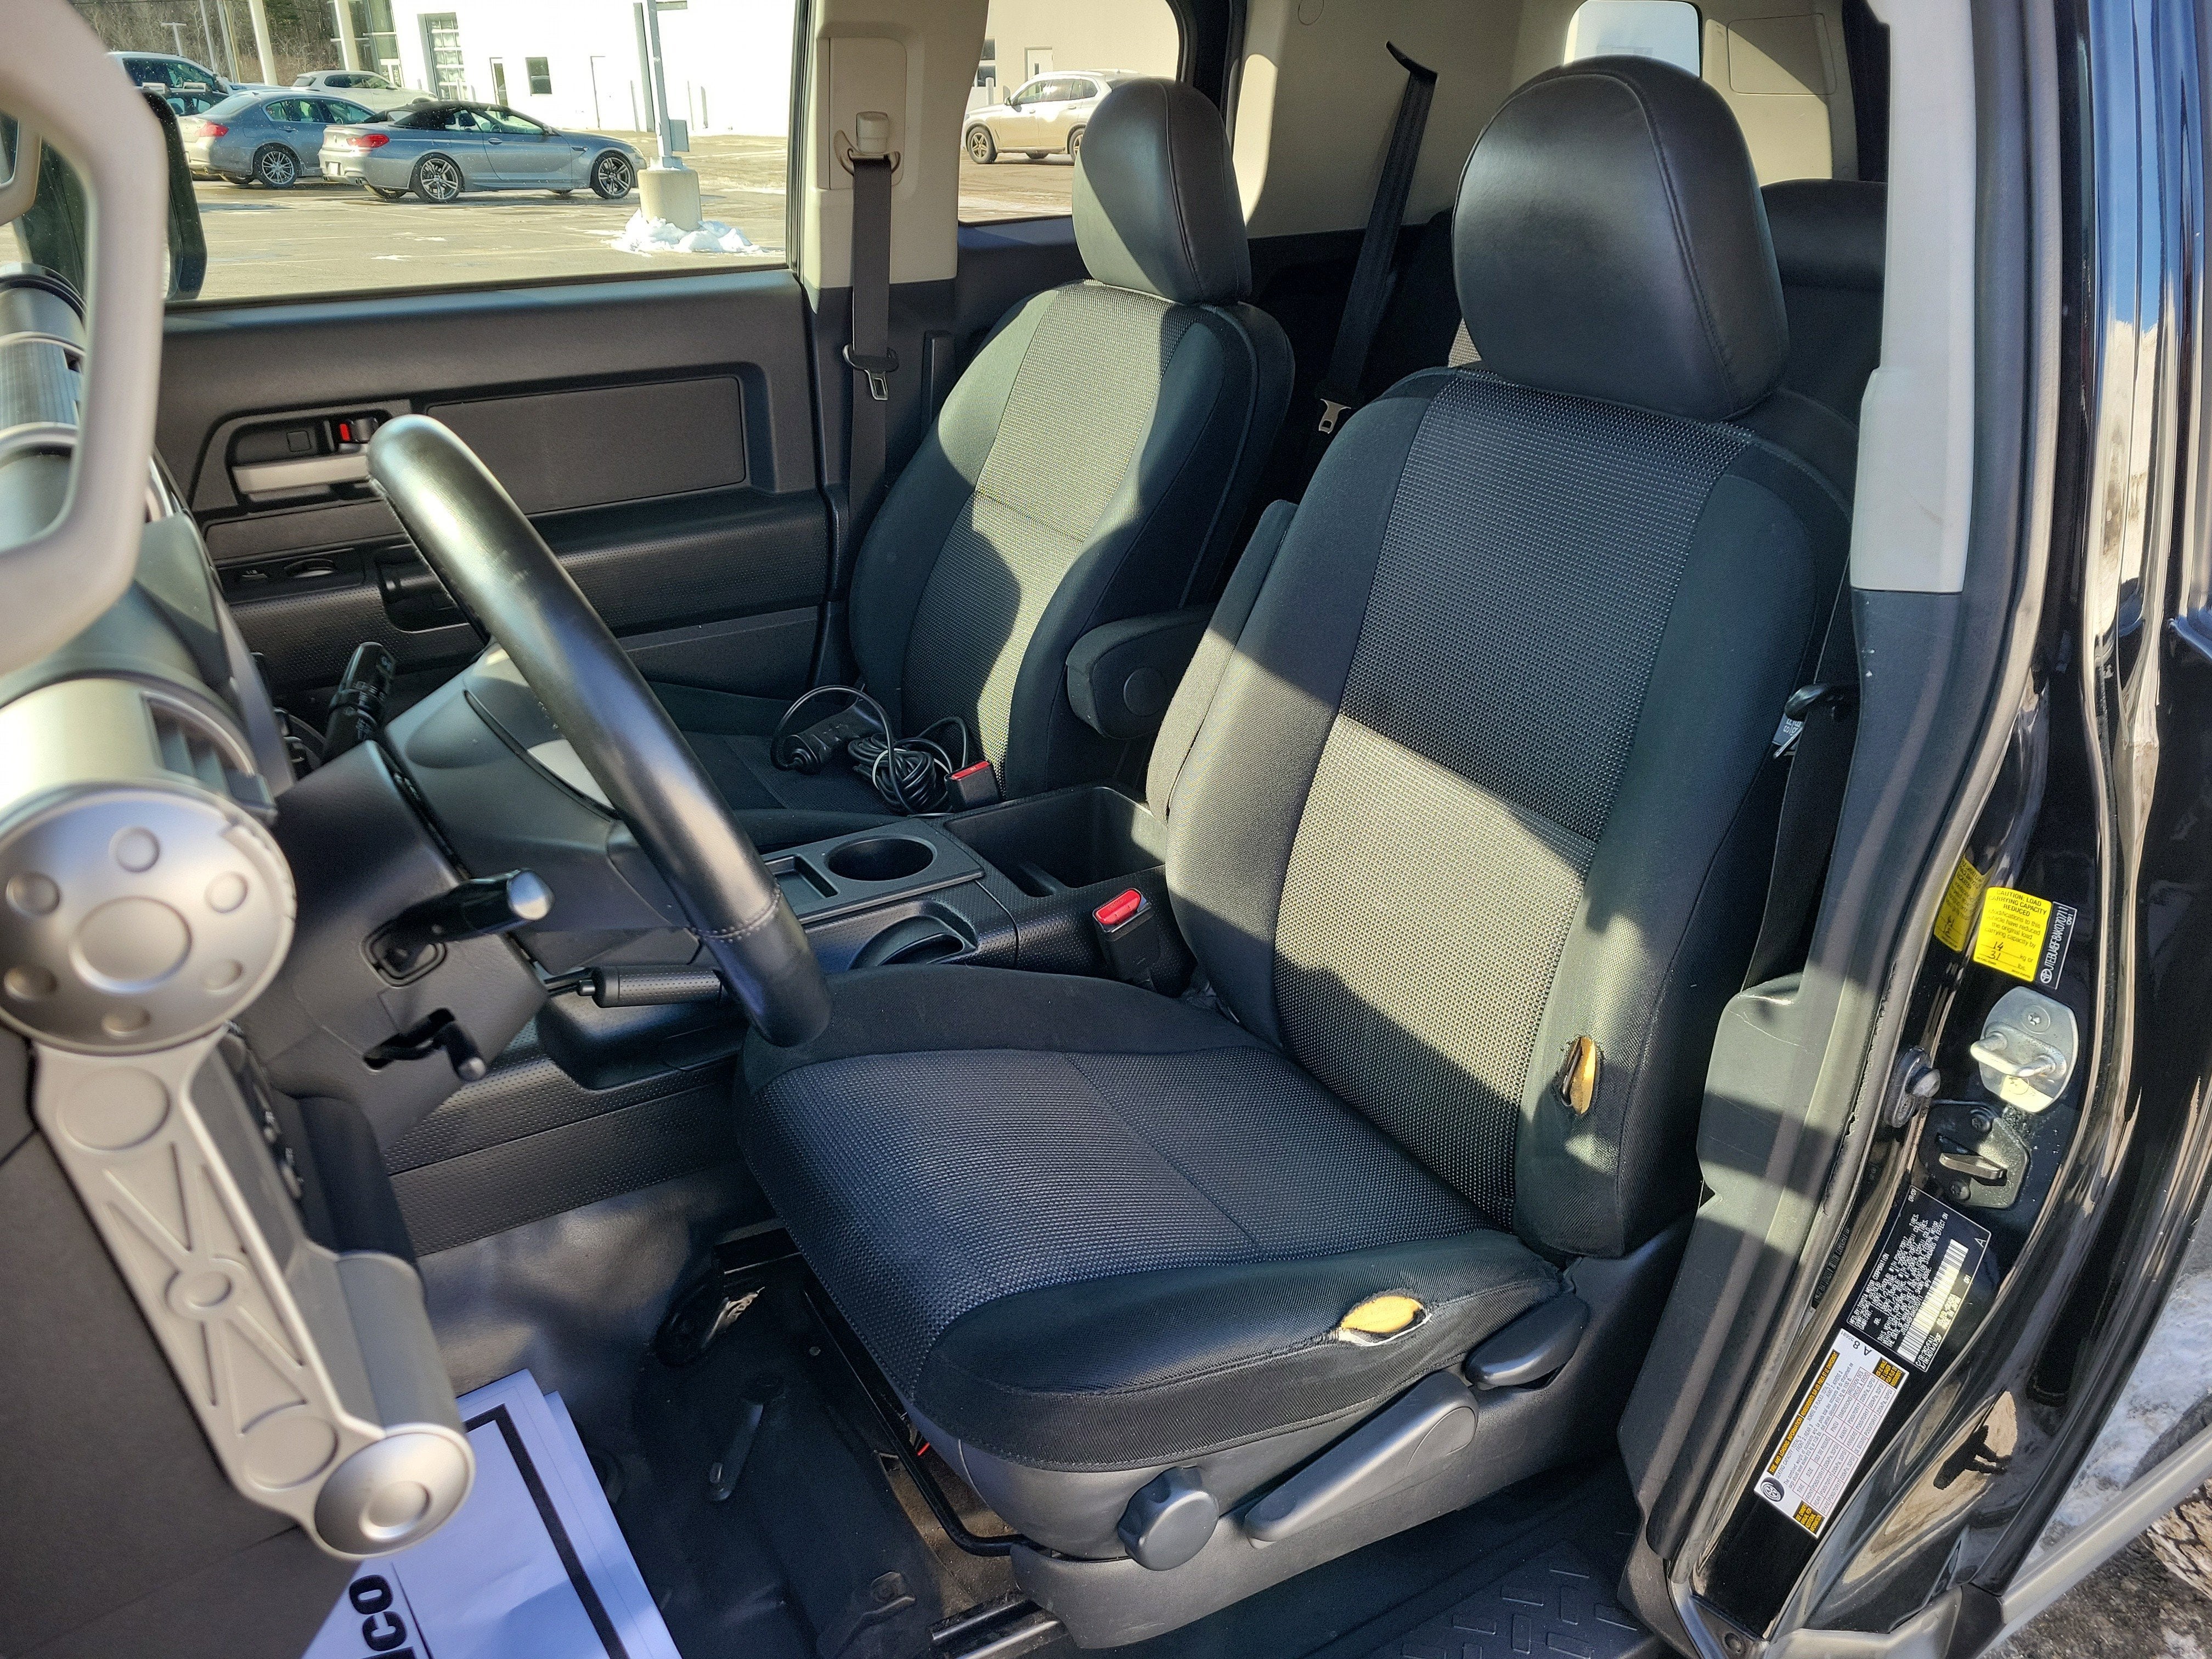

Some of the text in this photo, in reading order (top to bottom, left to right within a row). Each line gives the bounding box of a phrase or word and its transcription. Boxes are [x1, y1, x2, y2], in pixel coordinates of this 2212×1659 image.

[1988, 894, 2046, 915] CARRYING CAPACITY
[1996, 889, 2041, 906] CAUTION: LOAD
[2003, 904, 2030, 916] REDUCED
[1984, 927, 2006, 938] carrying
[2007, 934, 2028, 946] capacity
[2001, 925, 2020, 935] original
[2021, 931, 2033, 940] load
[2019, 924, 2040, 935] reduced
[1993, 940, 2004, 952] 14
[1907, 1187, 1917, 1203] 09/09
[1974, 1237, 1987, 1248] A
[1865, 1279, 1876, 1294] MOTOR
[1872, 1252, 1889, 1280] CORPORATION
[1877, 1330, 1886, 1342] THIS
[1883, 1312, 1895, 1331] VEHICLE
[1892, 1292, 1906, 1313] CONFORMS
[1911, 1252, 1925, 1277] APPLICABLE
[1922, 1234, 1934, 1252] FEDERAL
[1929, 1220, 1939, 1234] MOTOR
[1882, 1327, 1894, 1345] VEHICLE
[1891, 1311, 1903, 1327] SAFETY
[1899, 1301, 1908, 1312] AND
[1904, 1289, 1914, 1302] THEFT
[1911, 1263, 1926, 1289] PREVENTION
[1922, 1241, 1937, 1264] STANDARDS
[1936, 1219, 1945, 1235] EFFECT
[1887, 1338, 1895, 1347] THE
[1891, 1327, 1900, 1339] DATE
[1900, 1294, 1918, 1321] MANUFACTURE
[1914, 1279, 1925, 1294] SHOWN
[1863, 1347, 1872, 1356] A
[1848, 1377, 1859, 1395] PRESSION
[1837, 1395, 1853, 1418] DIMENSIONS
[1830, 1420, 1839, 1432] PNEU
[1838, 1426, 1848, 1440] AVANT
[1779, 1440, 1790, 1456] LOADING
[1787, 1416, 1802, 1441] INFORMATION
[1796, 1440, 1804, 1452] FRONT
[1775, 1464, 1785, 1479] SEATING
[1805, 1466, 1813, 1477] SIZE
[1804, 1488, 1814, 1502] FRONT
[1813, 1495, 1821, 1507] REAR
[1820, 1500, 1830, 1514] SPARE
